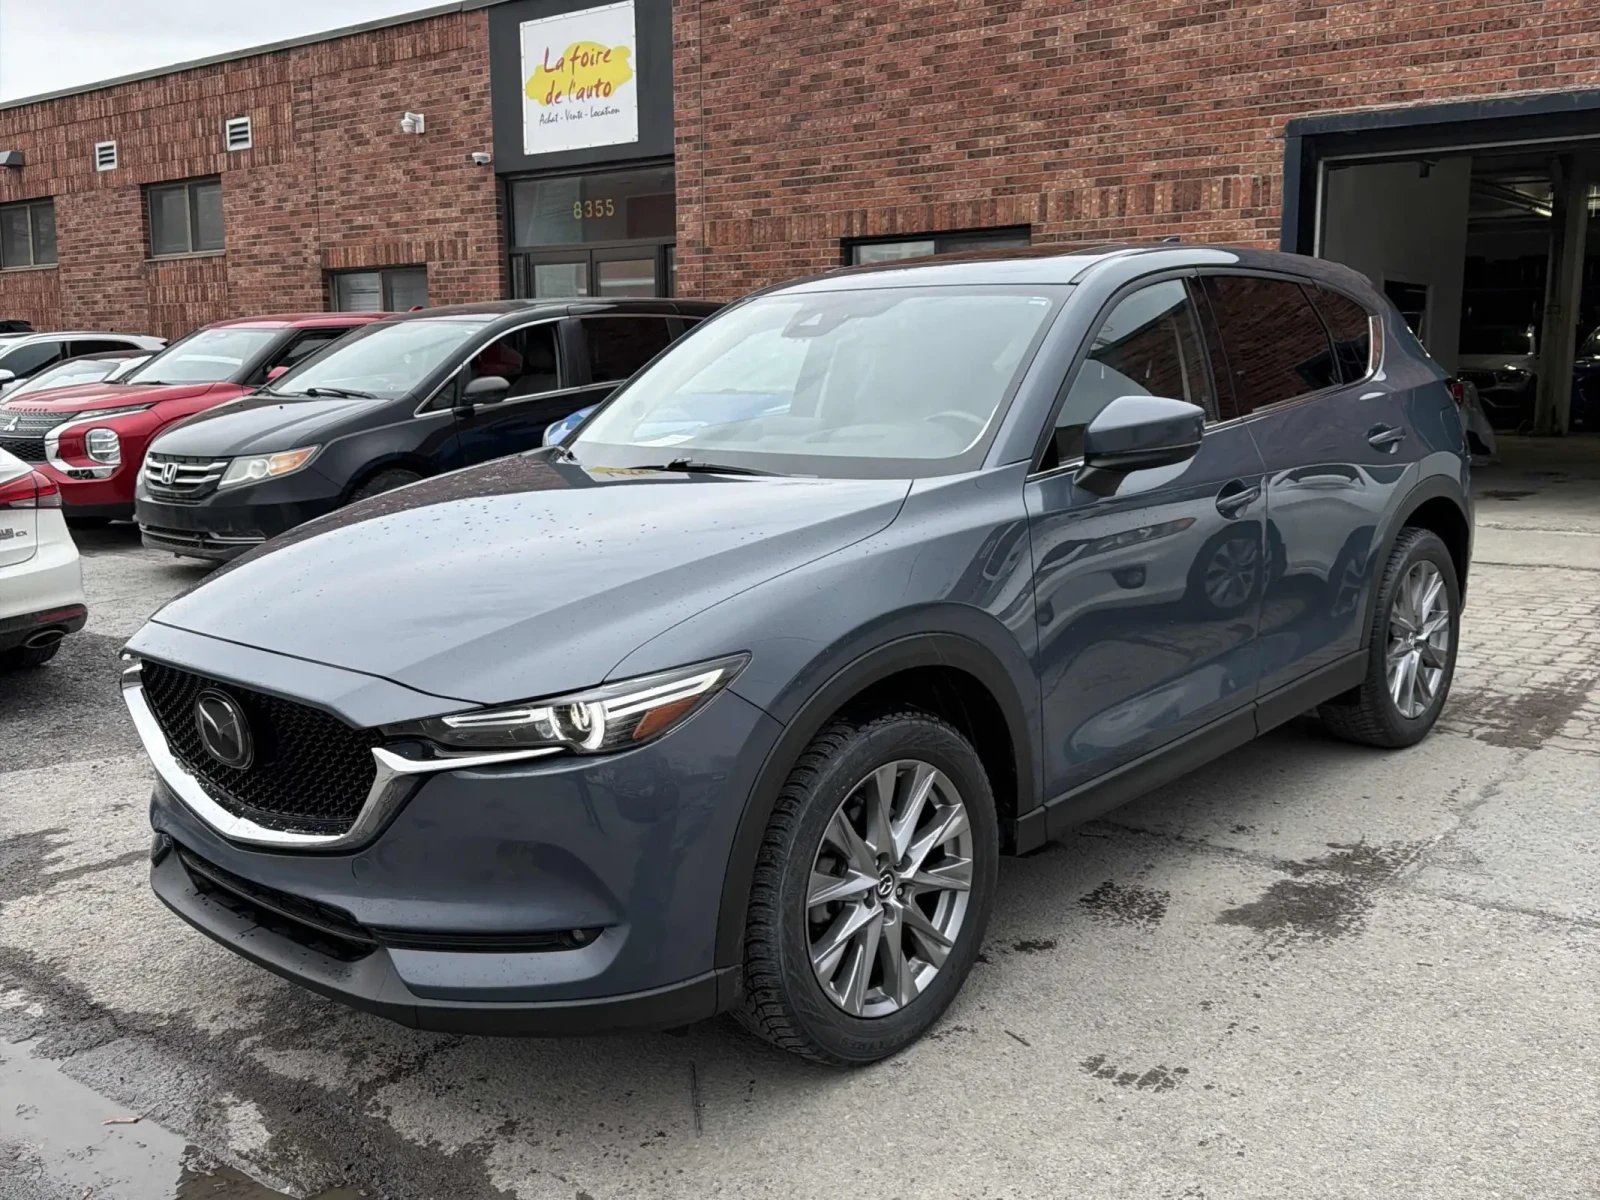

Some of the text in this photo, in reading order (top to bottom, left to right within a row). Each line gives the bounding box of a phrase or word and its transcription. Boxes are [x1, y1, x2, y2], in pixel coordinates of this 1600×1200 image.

[544, 45, 612, 75] La foire
[545, 78, 612, 106] de l'auto
[539, 112, 559, 126] Achat
[565, 109, 583, 121] Vente
[590, 106, 620, 118] Location
[573, 198, 615, 220] 8355
